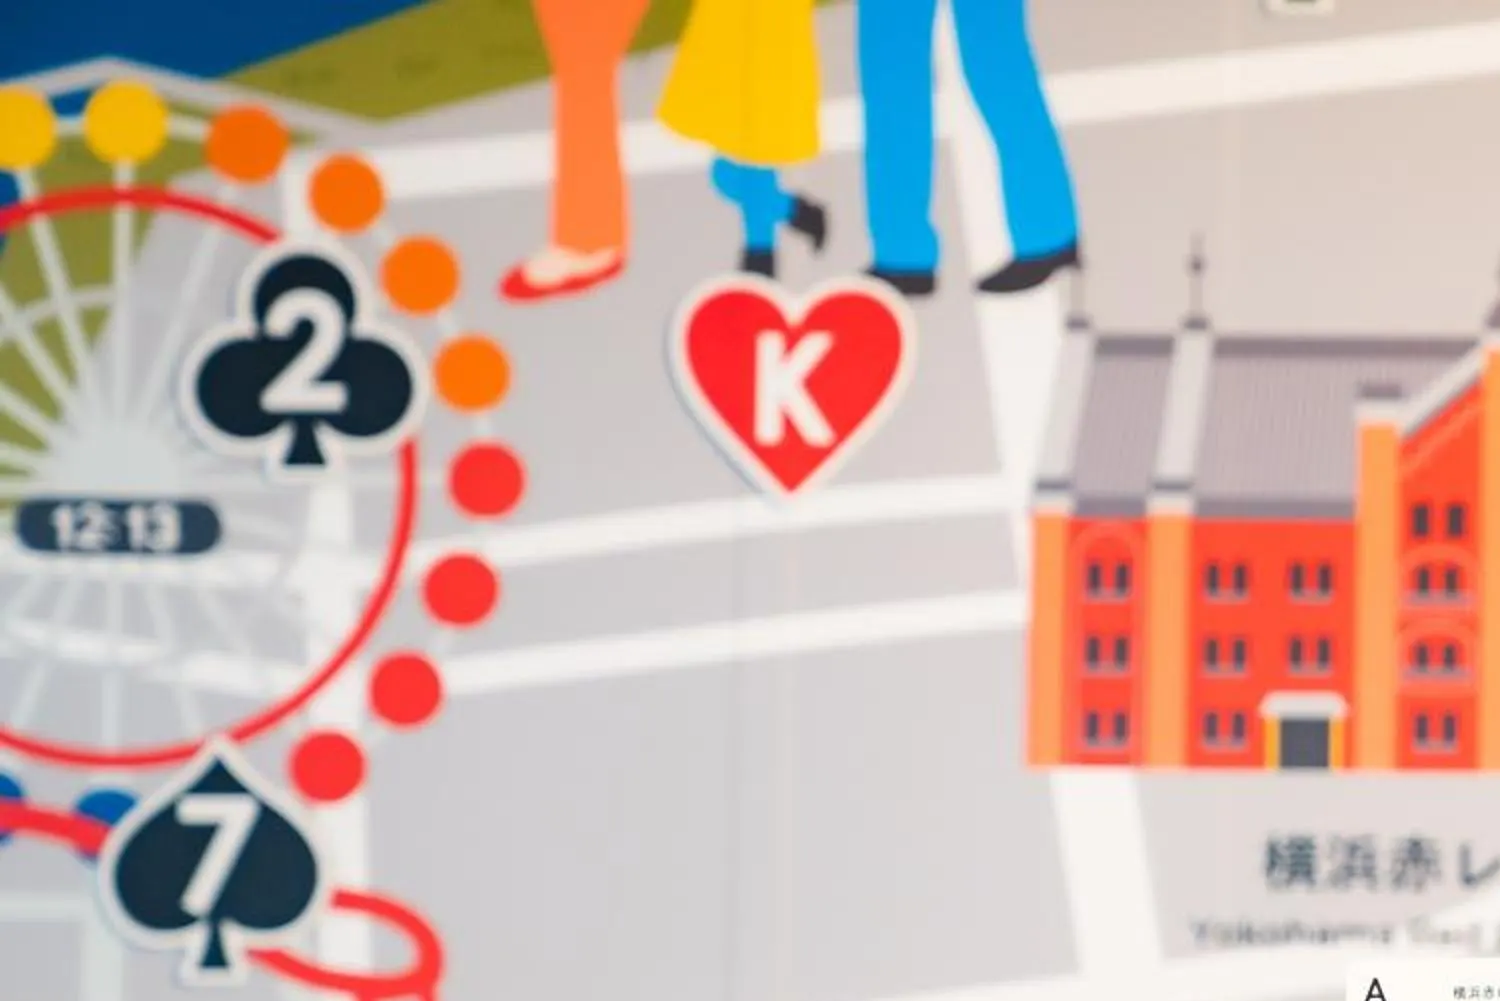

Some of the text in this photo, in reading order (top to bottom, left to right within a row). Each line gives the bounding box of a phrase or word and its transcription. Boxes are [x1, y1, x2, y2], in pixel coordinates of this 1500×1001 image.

[262, 288, 348, 412] 2
[754, 330, 834, 447] K
[52, 502, 181, 552] 12:13
[177, 793, 258, 916] 7
